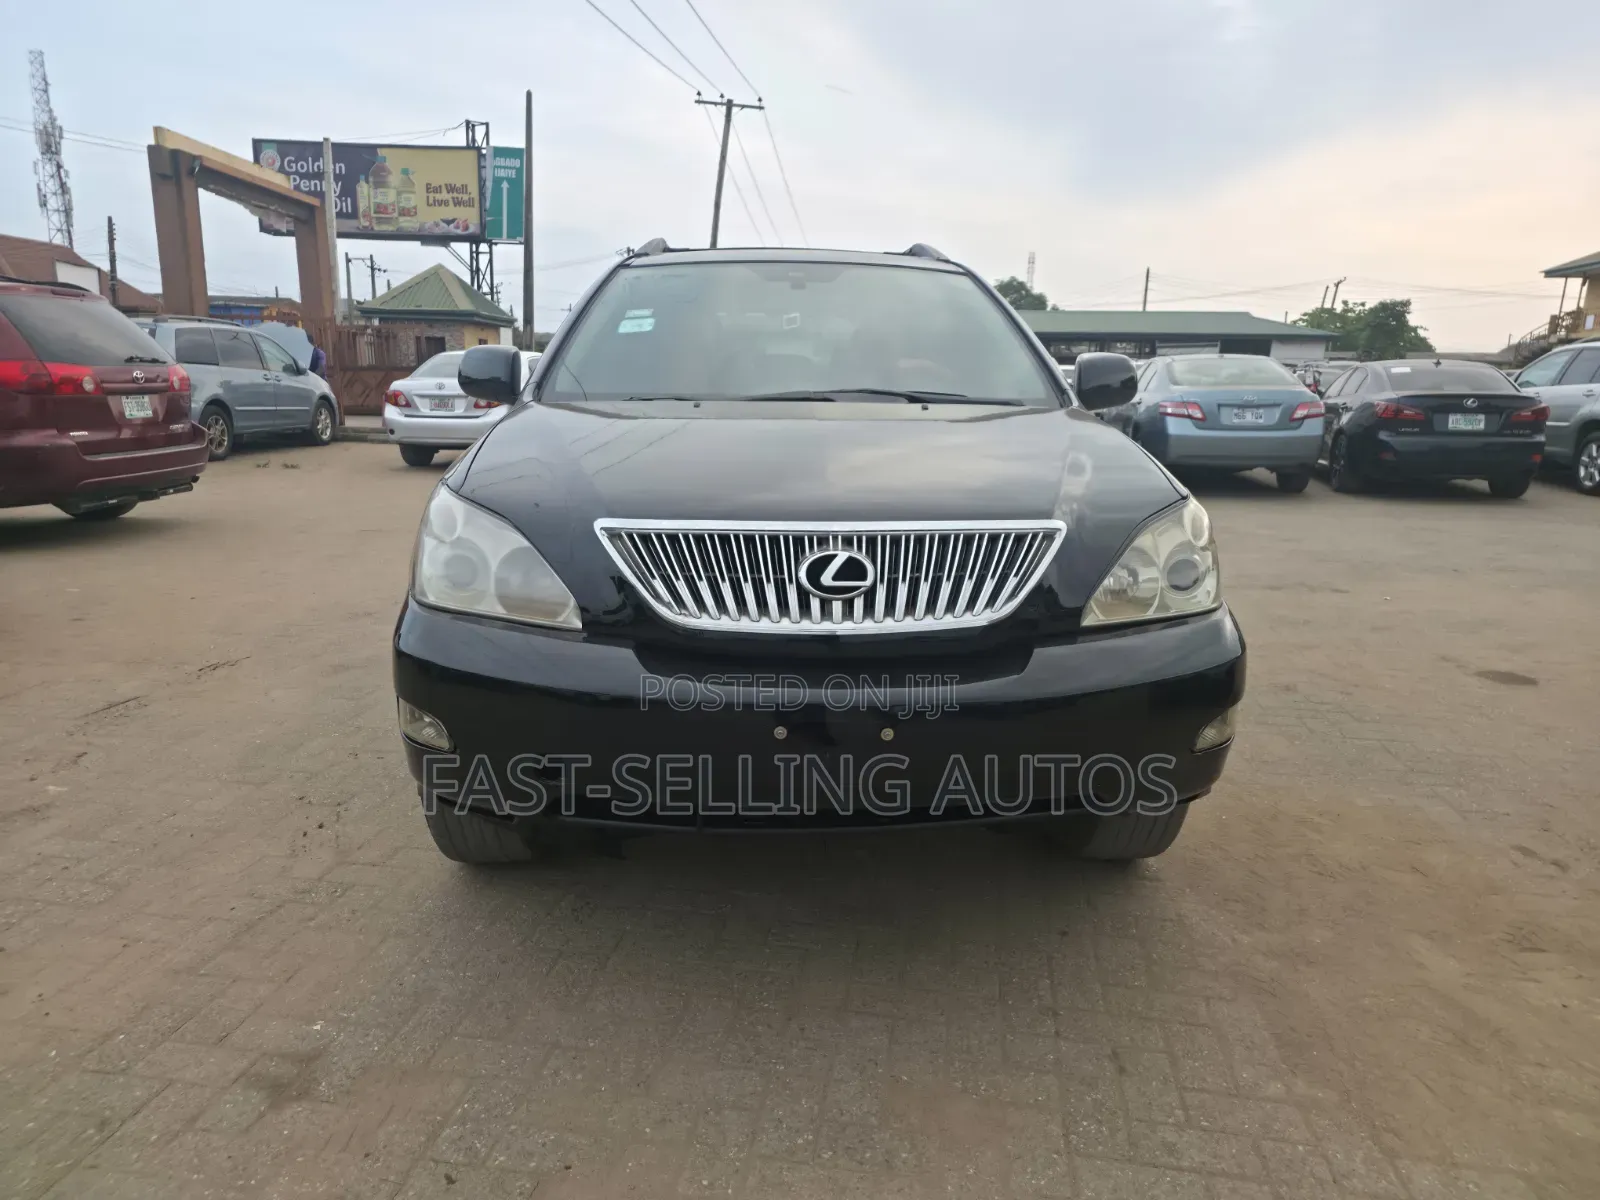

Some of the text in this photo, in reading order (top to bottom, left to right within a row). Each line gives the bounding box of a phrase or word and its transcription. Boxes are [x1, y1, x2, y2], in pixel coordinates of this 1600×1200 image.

[425, 182, 472, 196] Eat Well,
[426, 195, 450, 208] Live
[451, 196, 475, 208] Well
